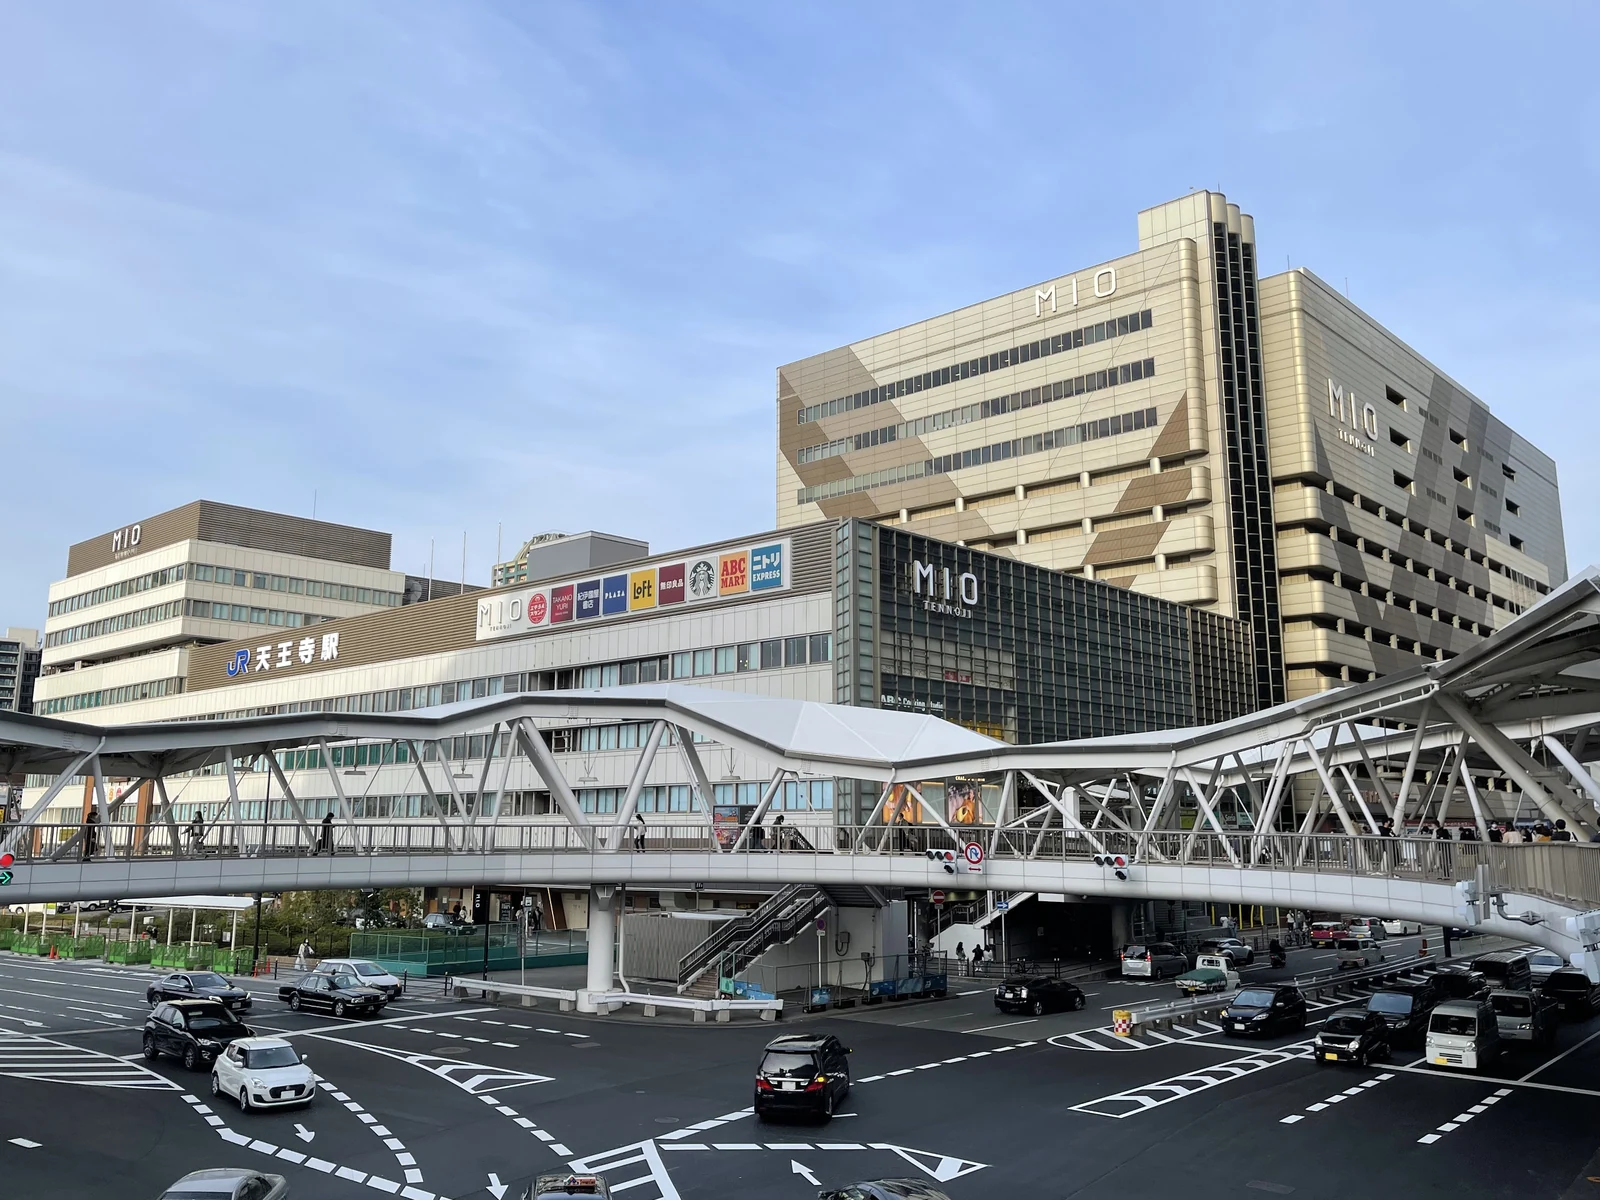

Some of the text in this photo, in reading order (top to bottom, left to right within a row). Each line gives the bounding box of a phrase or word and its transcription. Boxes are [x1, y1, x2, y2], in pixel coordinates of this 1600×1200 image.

[1035, 267, 1117, 317] MIO
[1327, 378, 1379, 441] MIO
[112, 524, 141, 553] MIO
[721, 557, 746, 577] ABC
[752, 552, 780, 571] ニトリ
[660, 578, 684, 591] 無印良品
[721, 574, 746, 589] MART
[752, 569, 781, 583] EXPRESS
[913, 560, 978, 605] MIO
[553, 594, 573, 604] TAKANO
[605, 590, 625, 600] PLAZA
[479, 598, 522, 628] MIO
[556, 602, 569, 611] YURI
[923, 600, 972, 619] TENNOJI
[226, 632, 340, 676] JR 天王寺駅
